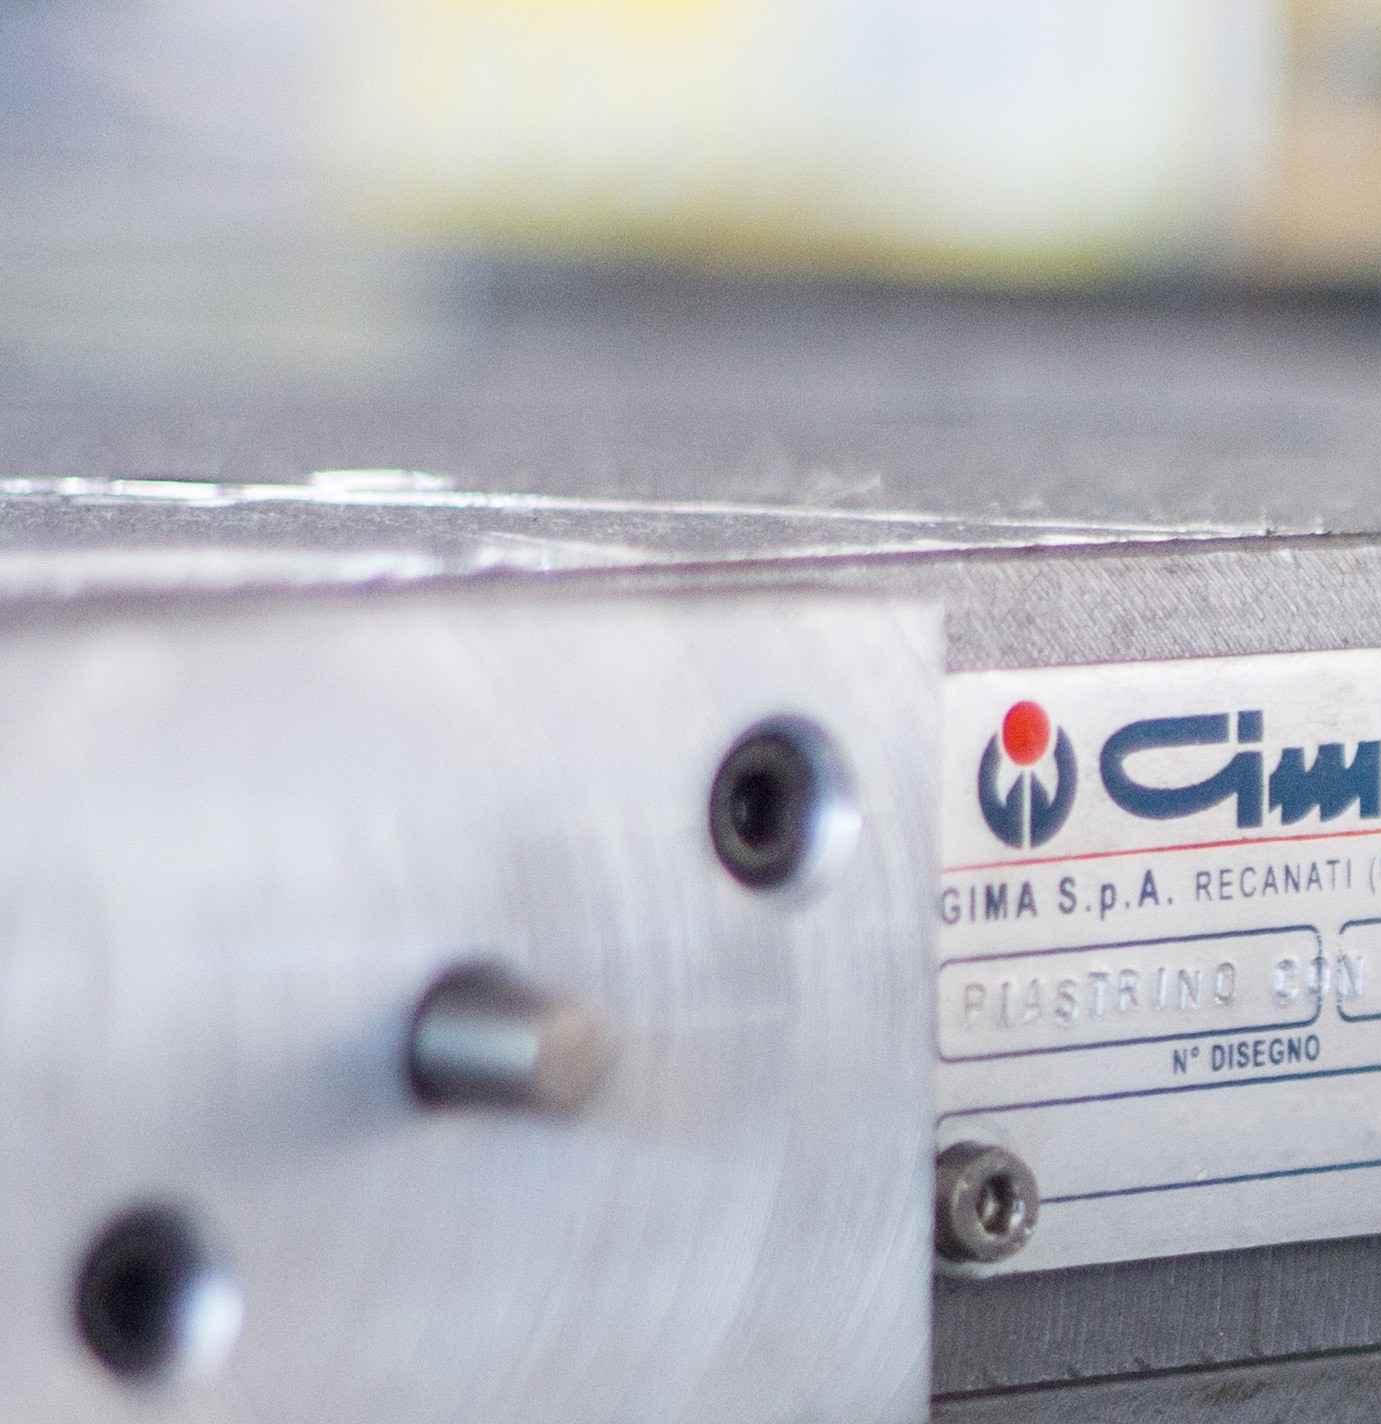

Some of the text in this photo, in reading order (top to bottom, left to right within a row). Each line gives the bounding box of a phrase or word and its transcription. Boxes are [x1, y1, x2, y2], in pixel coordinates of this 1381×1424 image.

[939, 880, 1039, 925] GIMA
[1057, 868, 1174, 921] S.p.A.
[1195, 858, 1352, 902] RECANATI
[962, 960, 1238, 1030] PIASTRINO
[1210, 1033, 1322, 1074] DISEGNO
